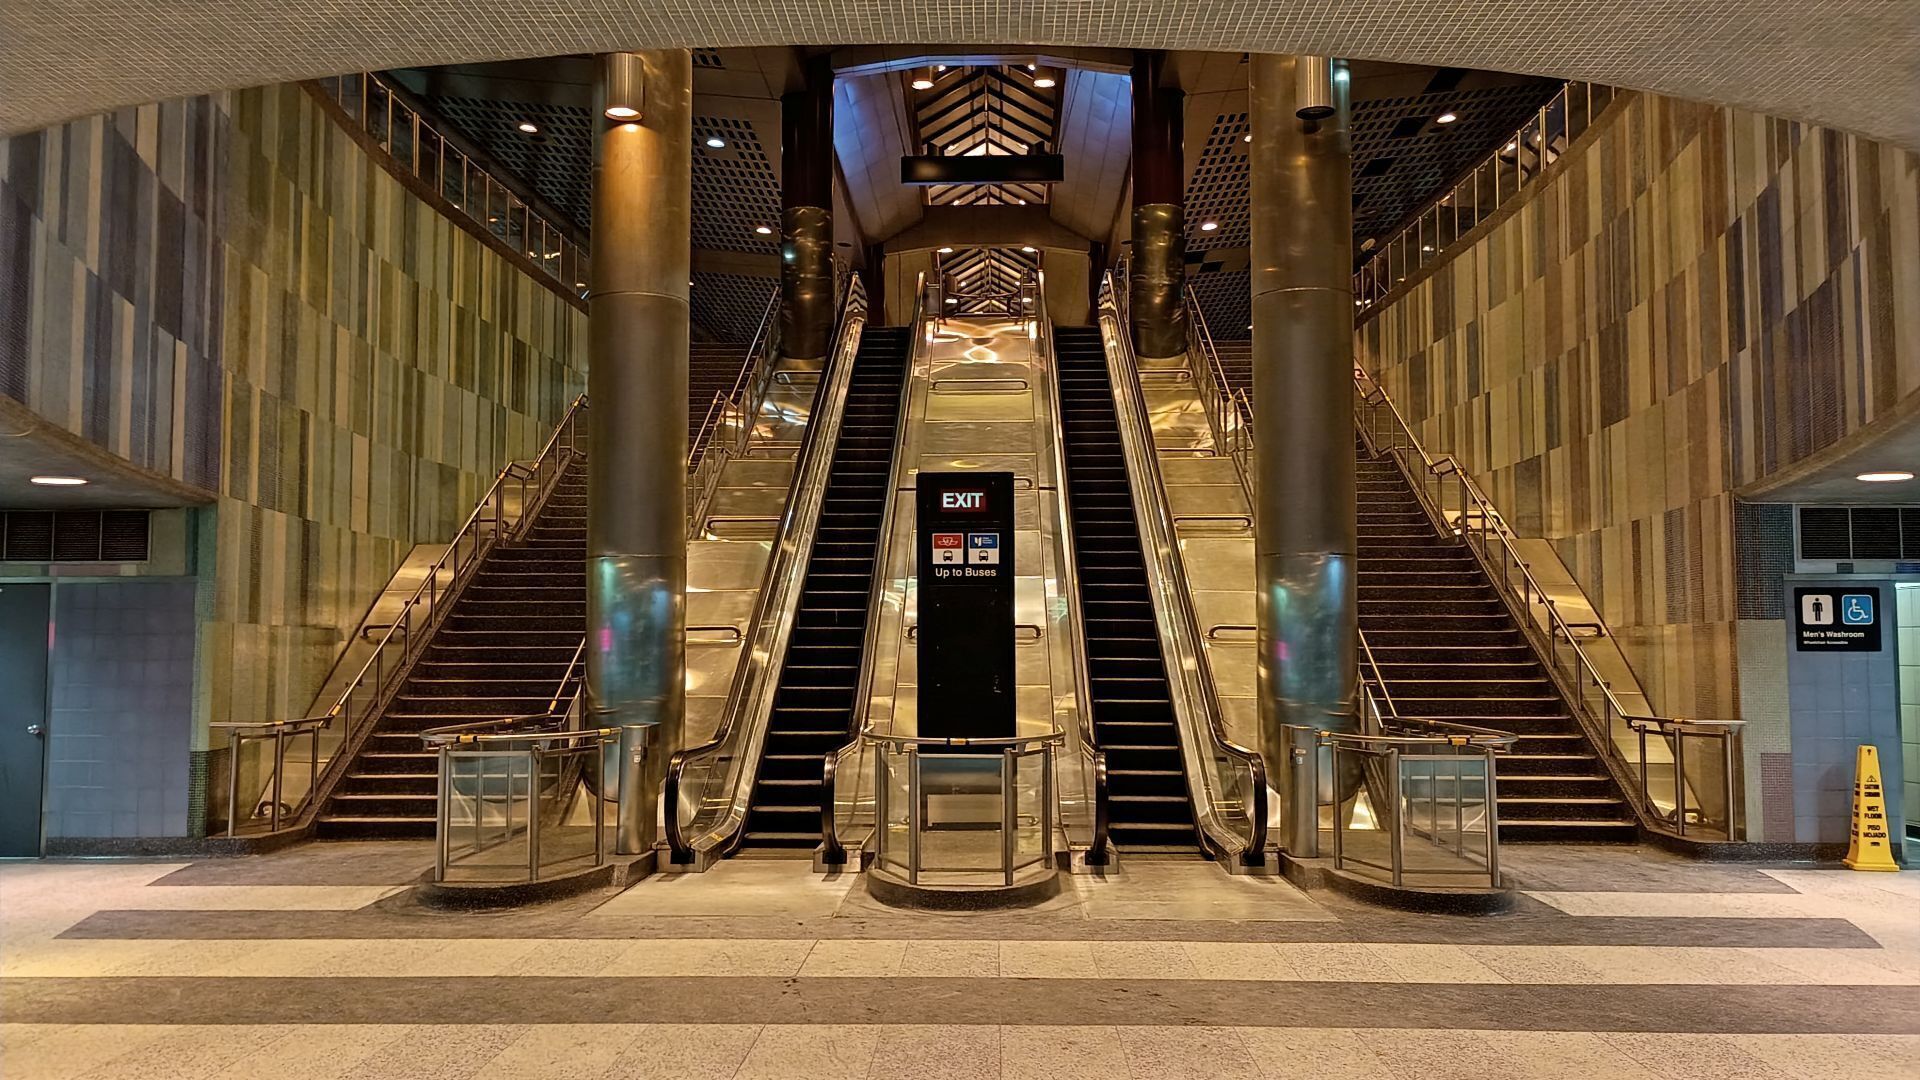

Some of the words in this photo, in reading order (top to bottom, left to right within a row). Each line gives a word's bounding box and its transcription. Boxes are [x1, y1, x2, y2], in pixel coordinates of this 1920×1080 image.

[943, 492, 983, 508] EXIT
[935, 567, 950, 578] Up
[952, 568, 963, 576] to
[965, 567, 997, 576] Buses
